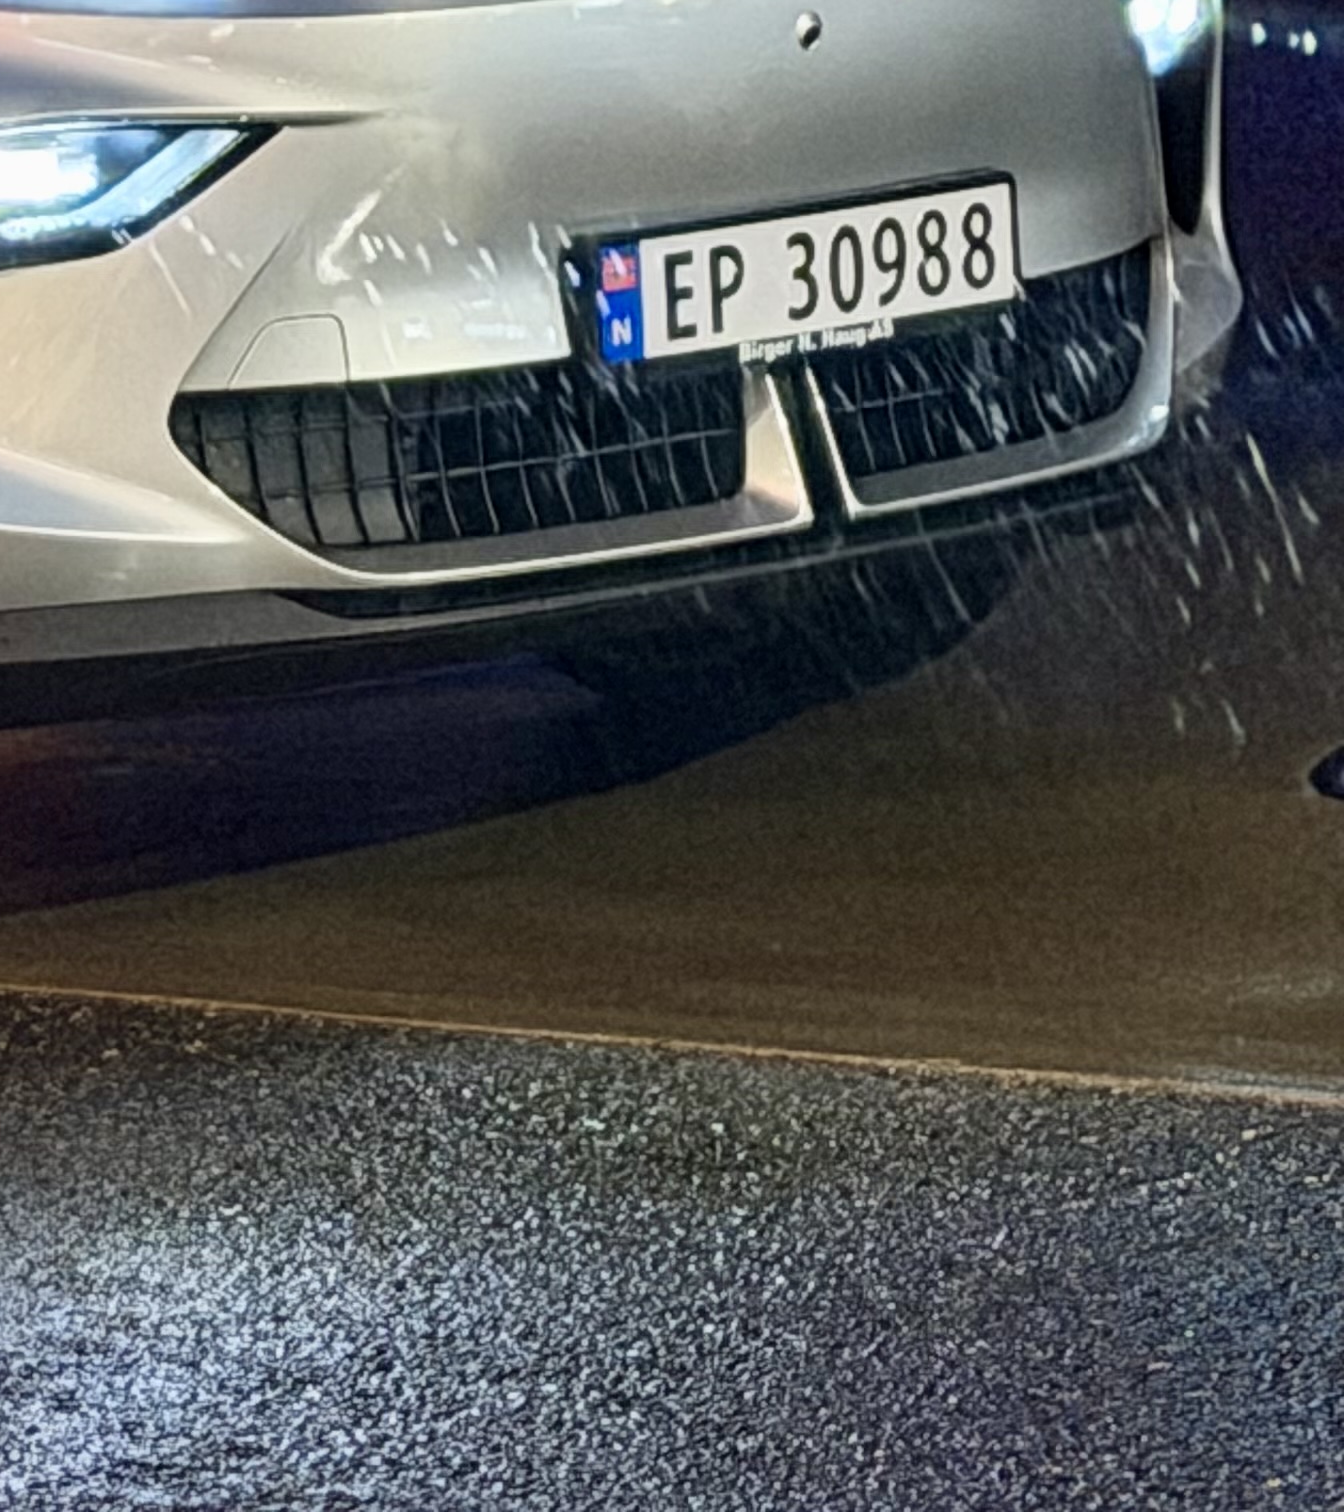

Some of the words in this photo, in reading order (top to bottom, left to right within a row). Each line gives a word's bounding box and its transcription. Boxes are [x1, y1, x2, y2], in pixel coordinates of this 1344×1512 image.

[664, 244, 745, 342] EP
[786, 201, 995, 321] 30988
[612, 317, 633, 345] N
